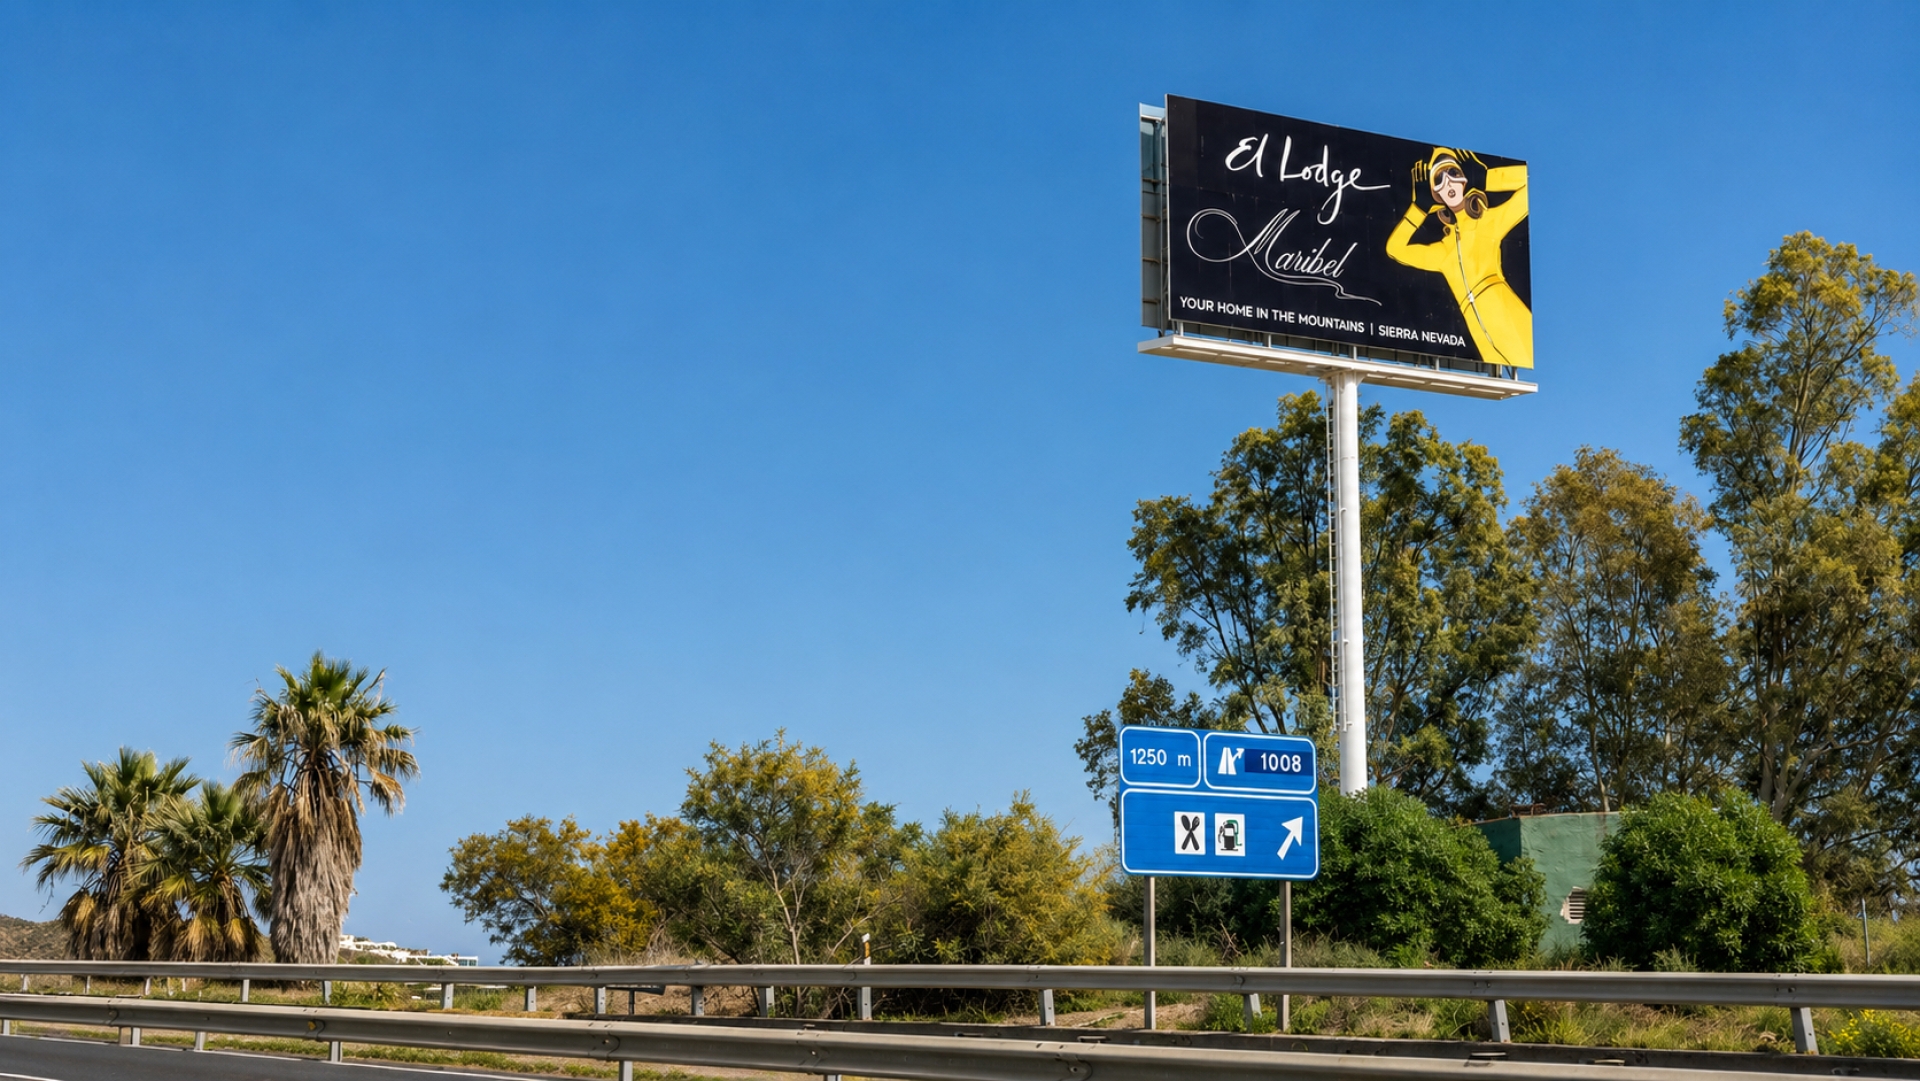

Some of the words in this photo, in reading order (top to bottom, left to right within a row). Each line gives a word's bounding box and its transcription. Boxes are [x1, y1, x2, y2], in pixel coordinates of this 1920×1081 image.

[1225, 134, 1268, 177] El
[1280, 136, 1391, 225] Lodge
[1187, 208, 1382, 306] Maribel
[1180, 296, 1214, 312] YOUR
[1217, 302, 1253, 318] HOME
[1256, 307, 1269, 319] IN
[1271, 309, 1295, 324] THE
[1298, 313, 1365, 333] MOUNTAINS
[1378, 325, 1419, 341] SIERRA
[1421, 330, 1466, 348] NEVADA
[1130, 748, 1167, 766] 1250
[1177, 754, 1192, 767] m
[1260, 752, 1302, 773] 1008
